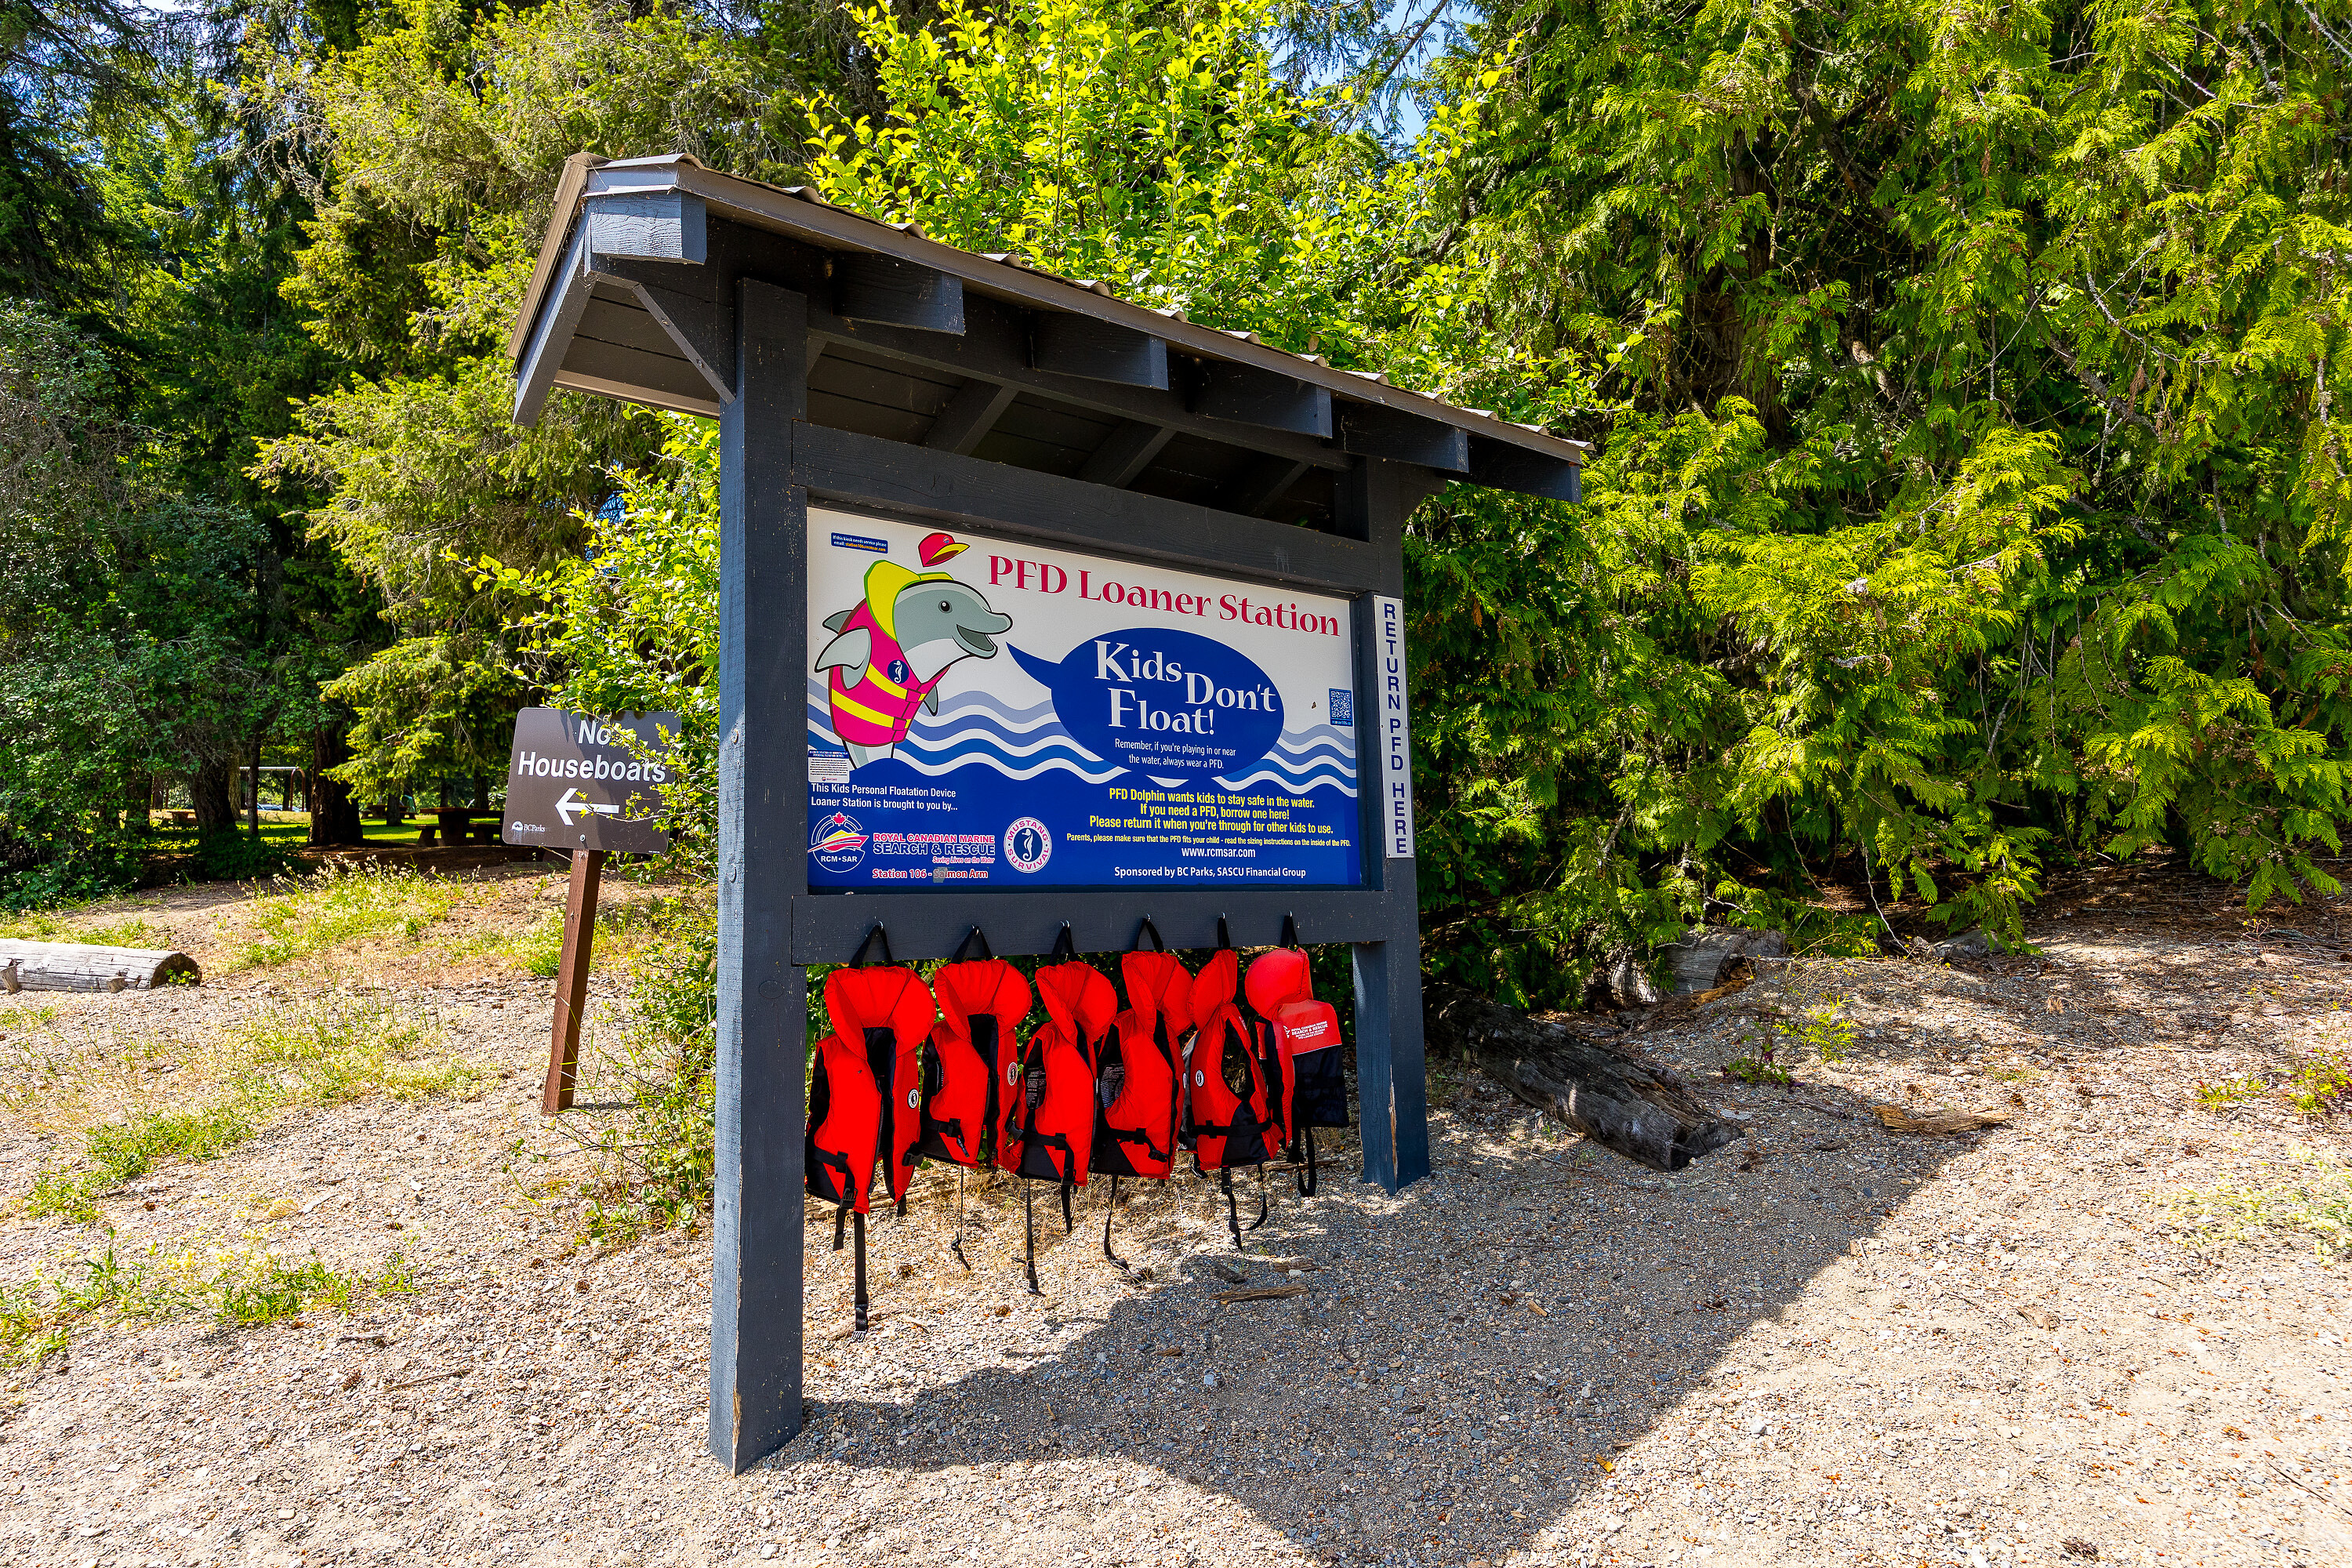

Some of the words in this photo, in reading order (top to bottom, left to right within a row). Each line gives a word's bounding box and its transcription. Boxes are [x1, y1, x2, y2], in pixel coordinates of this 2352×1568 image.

[988, 555, 1067, 593] PFD
[1078, 569, 1212, 616] Loaner
[1219, 593, 1340, 637] Station
[1384, 603, 1400, 710] RETURN
[1094, 640, 1181, 683] Kids
[1185, 672, 1276, 712] Don't
[1108, 688, 1214, 735] Float!
[578, 720, 612, 745] No
[1116, 739, 1152, 752] Remember,
[1155, 742, 1159, 750] if
[1160, 743, 1181, 753] you're
[1182, 744, 1204, 756] playing
[1207, 746, 1212, 754] in
[1390, 718, 1403, 771] PFD
[517, 751, 666, 782] Houseboats
[1129, 754, 1139, 763] the
[1142, 756, 1161, 766] water,
[1163, 757, 1185, 767] always
[1210, 760, 1224, 768] PFD.
[811, 783, 829, 793] This
[832, 785, 849, 793] Kids
[852, 786, 887, 795] Personal
[890, 787, 927, 796] Floatation
[931, 789, 956, 797] Device
[1109, 788, 1127, 800] PFD
[1131, 789, 1165, 803] Dolphin
[1167, 792, 1194, 803] wants
[1197, 792, 1214, 803] kids
[1218, 793, 1225, 804] to
[1228, 795, 1245, 807] stay
[1247, 795, 1265, 805] safe
[1267, 796, 1274, 806] in
[1276, 797, 1289, 807] the
[1291, 798, 1315, 808] water.
[811, 797, 840, 806] Loaner
[843, 798, 871, 807] Station
[874, 799, 880, 808] is
[884, 800, 914, 810] brought
[942, 801, 957, 811] by...
[1141, 804, 1147, 814] If
[1150, 807, 1165, 817] you
[1168, 805, 1189, 815] need
[1192, 808, 1197, 816] a
[1200, 806, 1219, 818] PFD,
[1221, 807, 1250, 818] borrow
[1253, 809, 1267, 818] one
[1269, 809, 1290, 819] here!
[1090, 815, 1120, 828] Please
[1123, 818, 1152, 828] return
[1154, 818, 1160, 829] it
[1163, 818, 1187, 829] when
[1189, 818, 1216, 832] you're
[1218, 820, 1250, 833] through
[1254, 821, 1265, 831] for
[1267, 822, 1287, 832] other
[1290, 822, 1306, 833] kids
[1308, 824, 1316, 833] to
[1318, 825, 1333, 833] use.
[1392, 782, 1407, 854] HERE
[873, 833, 906, 842] ROYAL
[907, 834, 956, 843] CANADIAN
[1007, 820, 1047, 841] MUSTANG
[1067, 833, 1092, 842] Parents,
[1247, 837, 1262, 846] sizing
[873, 843, 927, 855] SEARCH
[931, 844, 942, 855] &
[945, 844, 995, 855] RESCUE
[1181, 848, 1255, 858] www.rcmsar.com
[1007, 848, 1049, 869] SURVIVAL
[873, 869, 907, 878] Station
[909, 869, 927, 878] 106
[934, 869, 967, 878] Salmon
[969, 869, 988, 878] Arm
[1115, 867, 1162, 878] Sponsored
[1165, 867, 1175, 878] by
[1178, 867, 1188, 876] BC
[1190, 867, 1215, 877] Parks,
[1218, 867, 1243, 877] SASCU
[1246, 868, 1280, 877] Financial
[1283, 868, 1305, 878] Group
